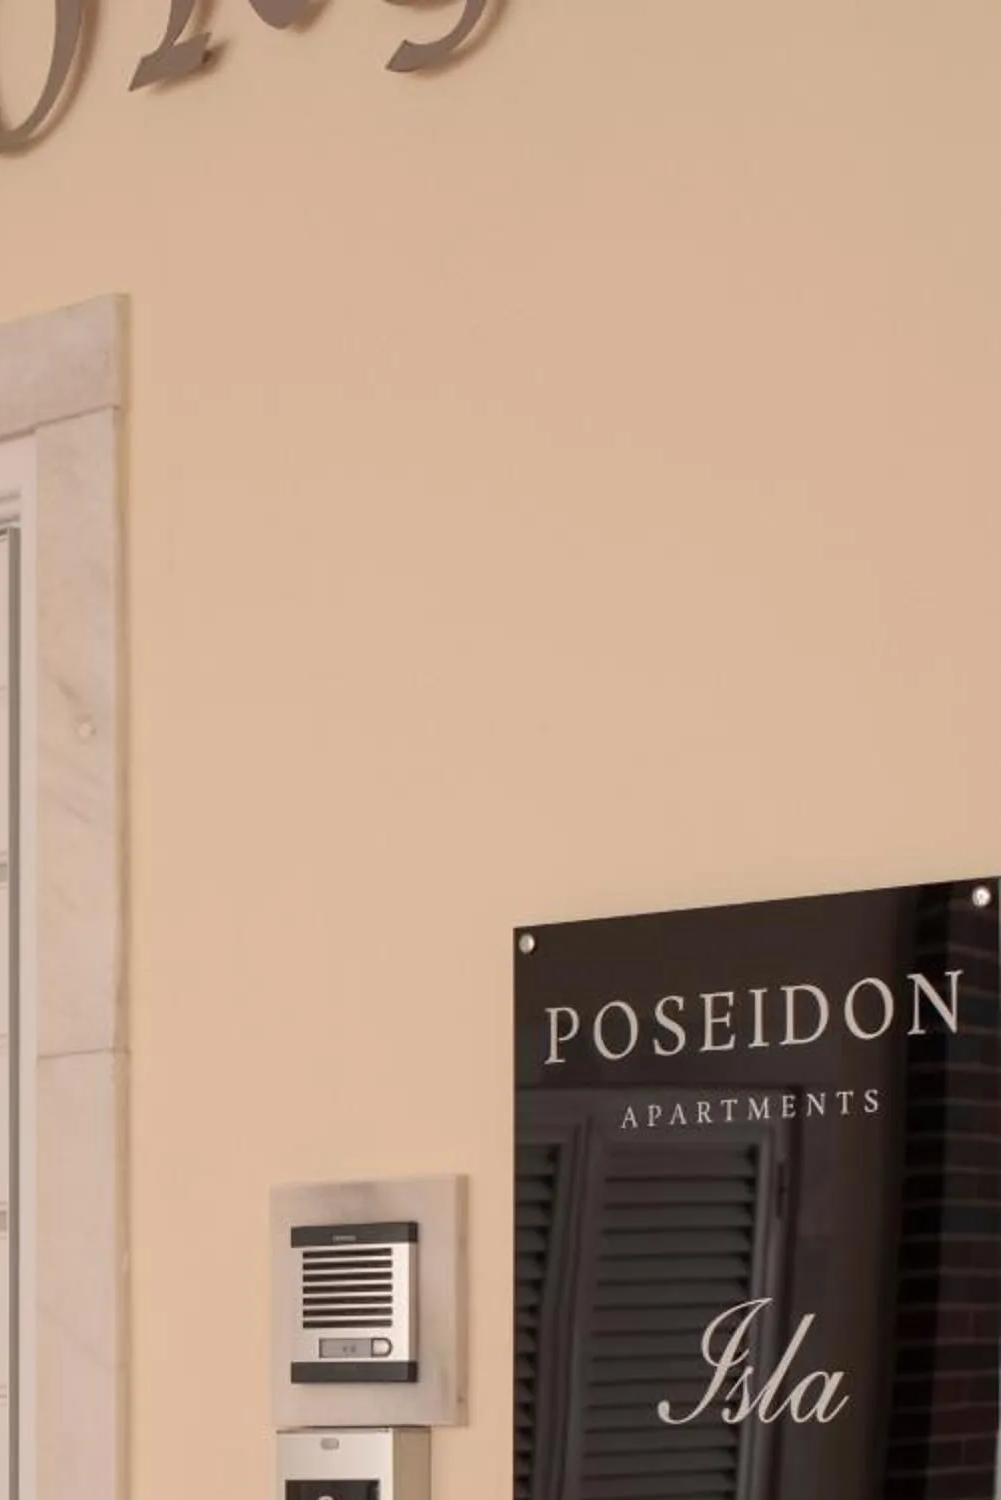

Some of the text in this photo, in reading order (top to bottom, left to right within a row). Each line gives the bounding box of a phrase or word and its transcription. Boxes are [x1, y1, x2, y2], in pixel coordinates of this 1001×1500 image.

[545, 970, 963, 1064] POSEIDON
[622, 1089, 879, 1129] APARTMENTS
[657, 1297, 849, 1425] Isla
